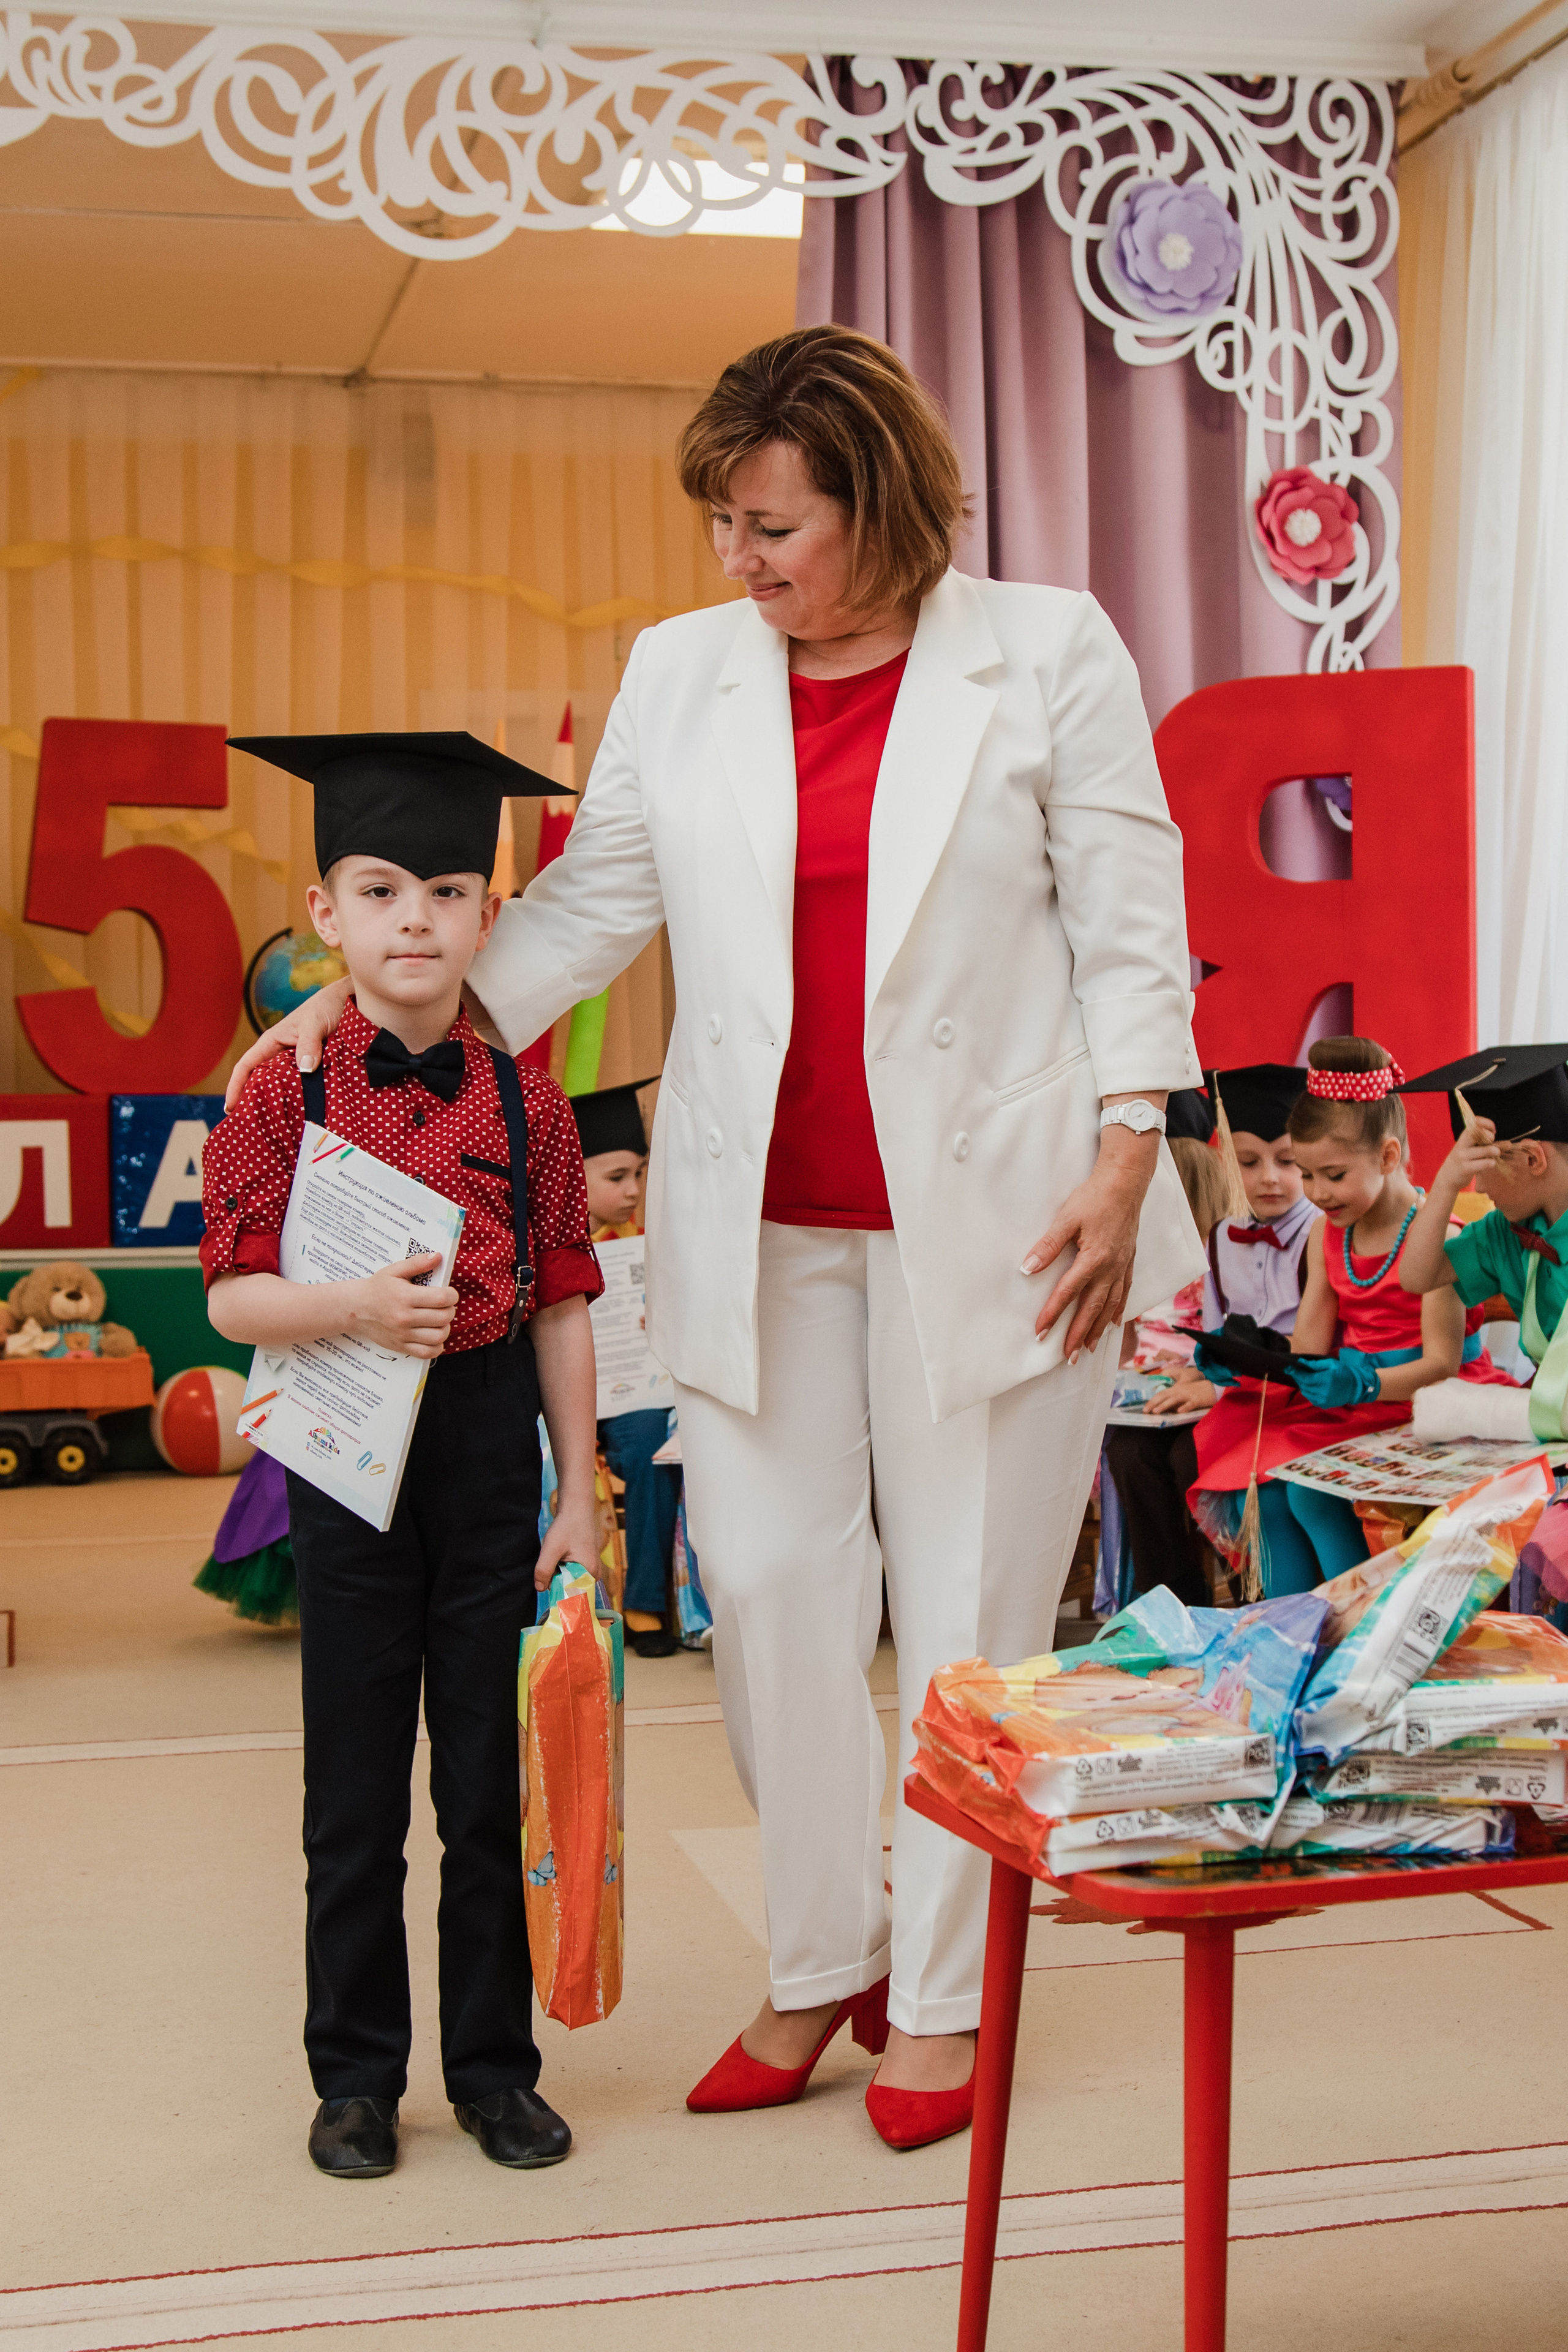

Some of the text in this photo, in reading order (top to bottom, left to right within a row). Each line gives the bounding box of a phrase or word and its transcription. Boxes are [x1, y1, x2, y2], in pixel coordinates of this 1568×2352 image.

[16, 717, 243, 1095] 5
[304, 1194, 321, 1205] нажимаем
[305, 1186, 321, 1199] Наведите
[320, 1196, 333, 1207] камеру
[306, 1179, 322, 1192] Откройте
[326, 1191, 336, 1200] своем
[336, 1197, 352, 1210] телефоне
[313, 1171, 410, 1232] Сначала попробуйте быстрый способ оживления:
[337, 1169, 368, 1191] Инструкция
[374, 1192, 404, 1213] оживлению
[404, 1210, 426, 1225] альбома
[299, 1213, 314, 1224] Наводим
[330, 1232, 354, 1248] наслаждаемся
[300, 1205, 309, 1214] Еще
[314, 1215, 332, 1227] сканируем
[339, 1229, 361, 1245] дожидаемся
[360, 1242, 378, 1254] окончания
[302, 1200, 321, 1213] Действуем
[320, 1211, 335, 1222] согласно
[334, 1219, 356, 1234] инструкциям
[360, 1235, 373, 1244] экране
[301, 1244, 306, 1255] 1
[306, 1250, 328, 1265] приложение
[308, 1257, 319, 1266] найти
[311, 1233, 321, 1243] Если
[326, 1244, 352, 1261] получилось?
[312, 1245, 330, 1260] Загрузите
[343, 1265, 361, 1278] смартфон
[326, 1346, 337, 1355] 15-20
[350, 1362, 364, 1372] важно!
[332, 1344, 357, 1362] фотографией
[361, 1362, 382, 1378] расстоянии
[356, 1340, 371, 1352] QR-код
[290, 1365, 298, 1374] Если
[304, 1376, 322, 1390] выполнили
[328, 1392, 352, 1409] предыдущие
[296, 1357, 316, 1372] попробуйте
[335, 1382, 349, 1393] камеру
[319, 1359, 333, 1371] камеру
[332, 1367, 354, 1383] приложения
[353, 1381, 371, 1393] слишком
[327, 1370, 342, 1383] поэтому
[350, 1385, 360, 1393] фото
[290, 1396, 302, 1406] вашем
[301, 1404, 315, 1414] альбоме
[295, 1376, 307, 1385] значит
[306, 1384, 318, 1393] перед
[326, 1396, 339, 1407] сейчас
[307, 1429, 328, 1447] Albums
[328, 1442, 340, 1455] kids
